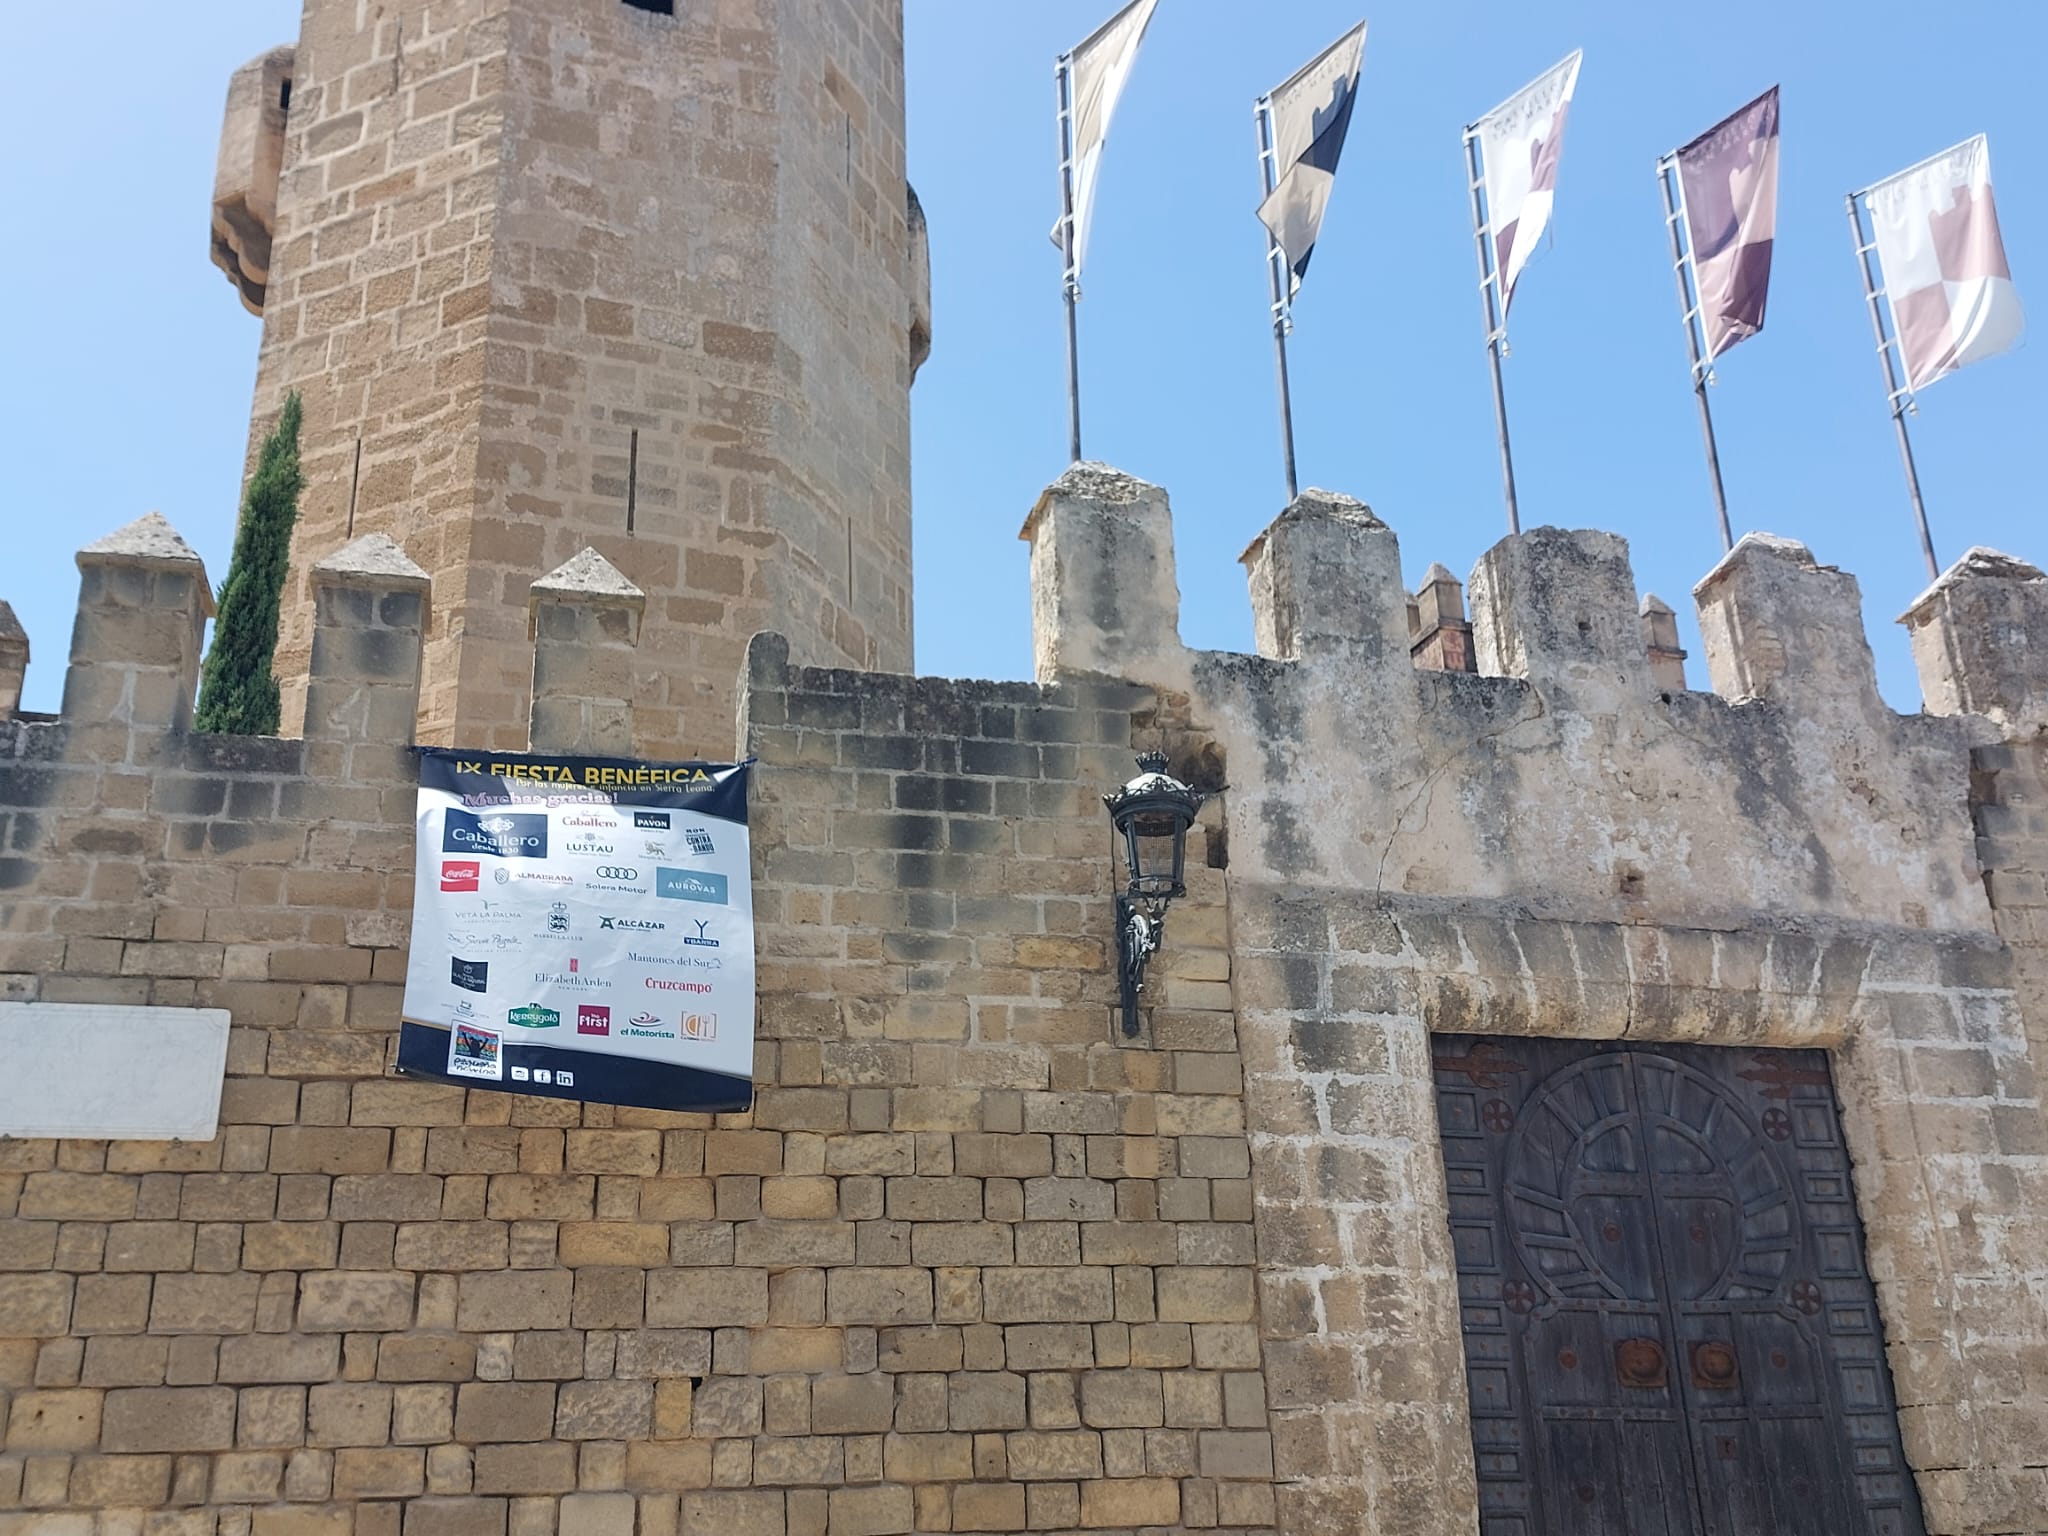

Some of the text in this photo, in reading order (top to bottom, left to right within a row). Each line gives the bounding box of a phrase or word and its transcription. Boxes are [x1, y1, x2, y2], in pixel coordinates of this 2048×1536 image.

[456, 761, 710, 785] IX FIESTA BENÉFICA
[655, 784, 682, 793] Sierra
[563, 815, 618, 828] Caballero
[452, 828, 540, 847] Caballero
[566, 842, 614, 853] LUSTAU
[585, 882, 616, 892] Solera
[618, 885, 648, 895] Motor
[667, 881, 716, 894] AUROVAS
[617, 919, 665, 931] ALCÁZAR
[628, 952, 675, 965] Mantones
[676, 959, 692, 967] del
[535, 973, 612, 987] Elizabeth Arden
[645, 977, 712, 994] Cruzcampo
[620, 1028, 629, 1036] el
[631, 1029, 675, 1039] Motorista
